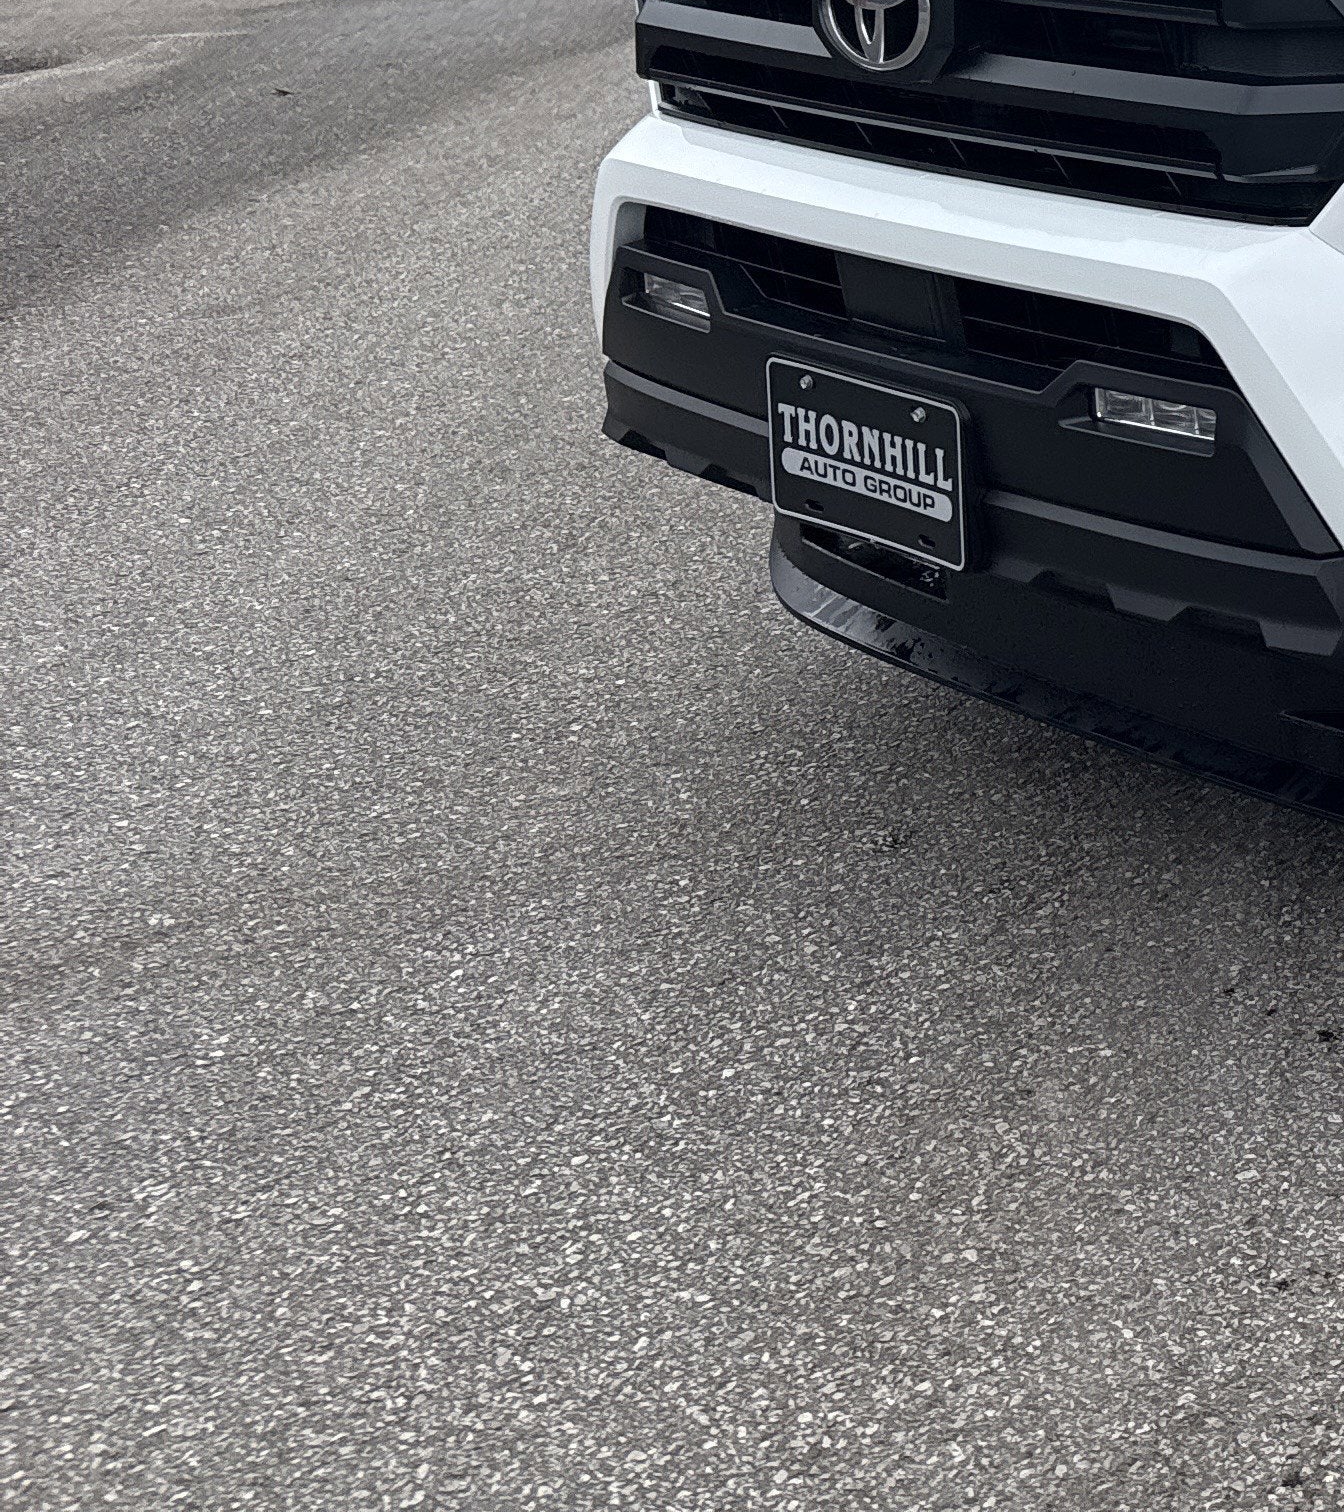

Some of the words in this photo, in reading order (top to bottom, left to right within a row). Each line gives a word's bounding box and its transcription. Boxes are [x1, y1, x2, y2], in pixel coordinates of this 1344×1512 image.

[777, 402, 953, 492] THORNHILL
[800, 456, 857, 488] AUTO
[863, 475, 935, 511] GROUP
